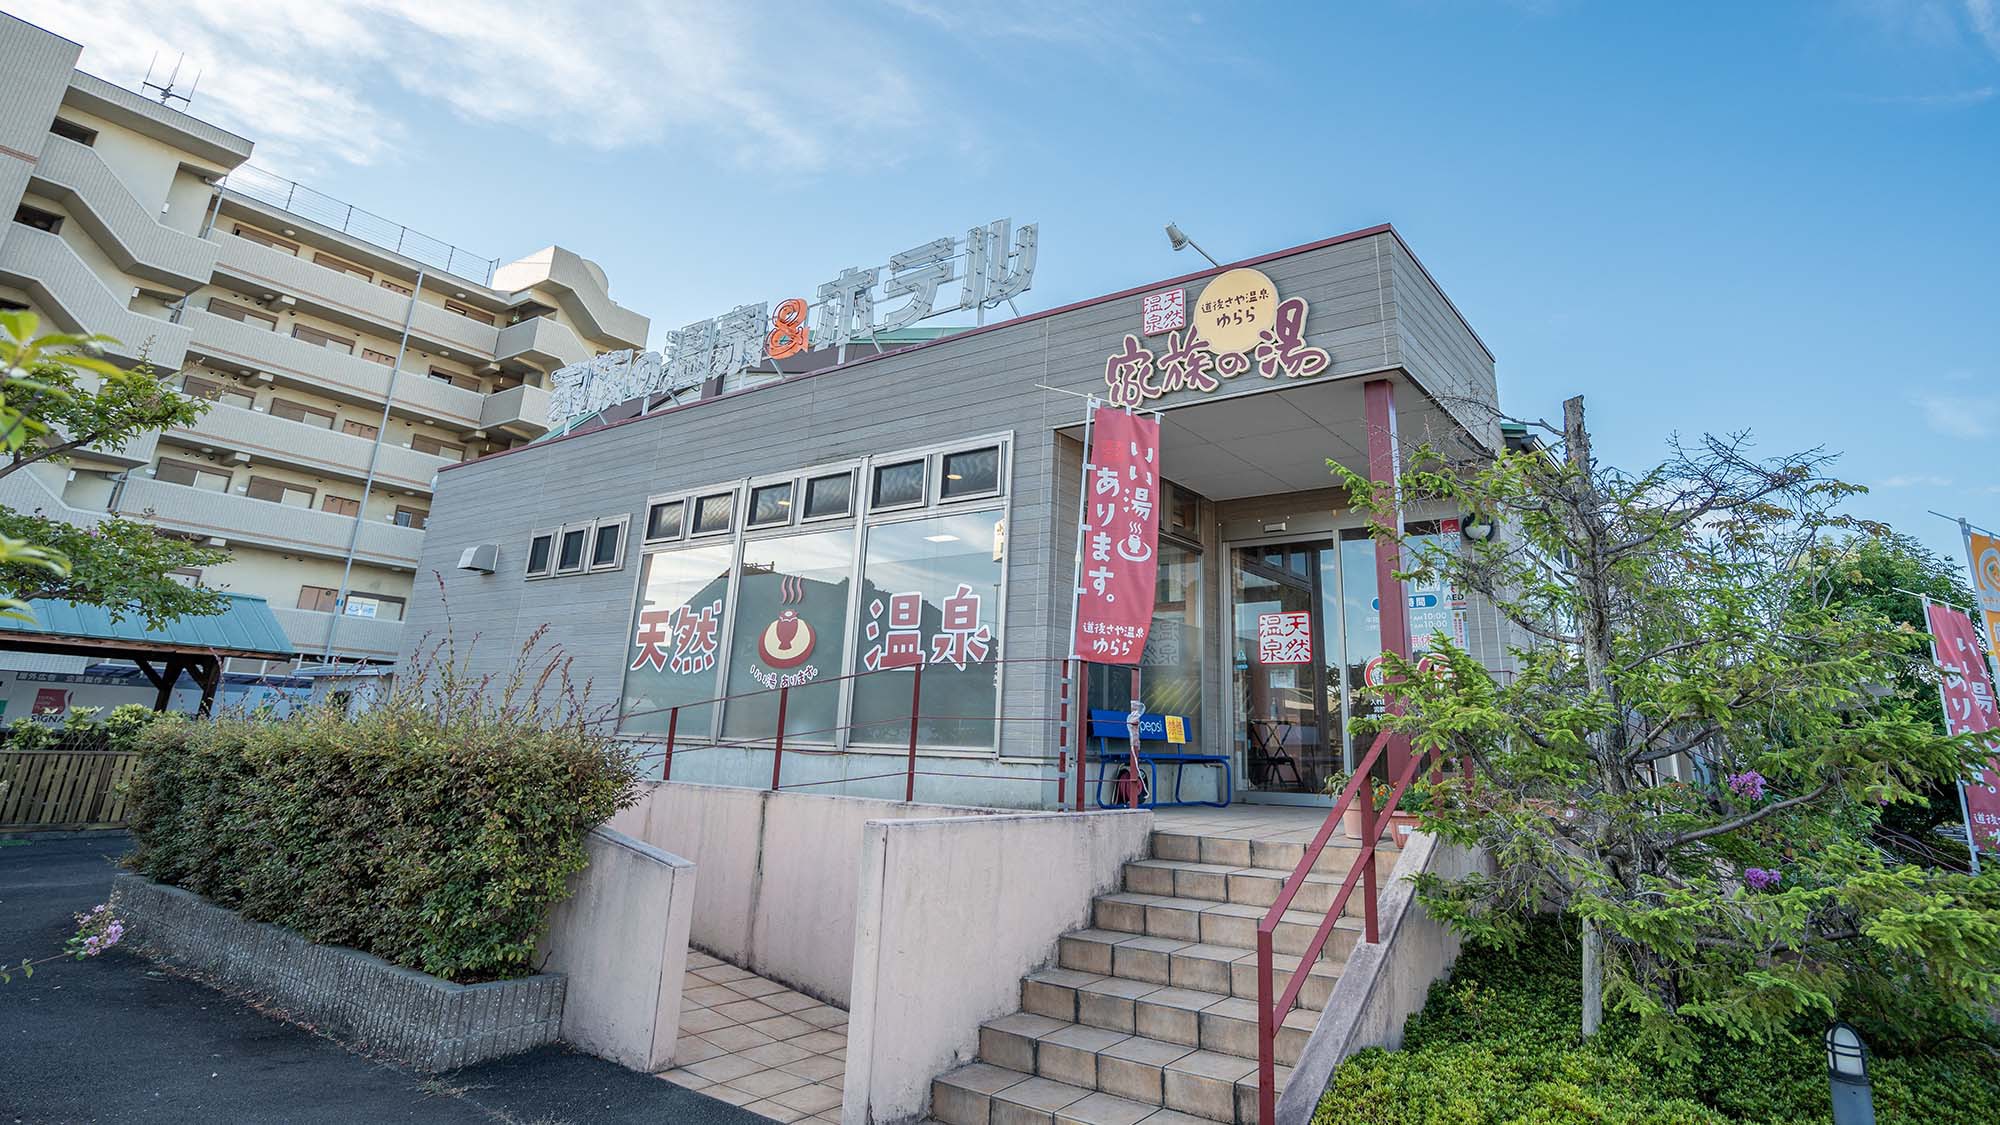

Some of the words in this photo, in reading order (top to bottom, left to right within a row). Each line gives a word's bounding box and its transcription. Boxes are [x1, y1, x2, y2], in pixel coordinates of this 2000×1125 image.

[1201, 287, 1269, 314] 道後さや温泉
[1216, 306, 1256, 329] ゆらら
[1106, 297, 1331, 407] 家族の湯
[1123, 441, 1154, 521] いい湯
[1087, 466, 1120, 603] あります。
[630, 598, 724, 675] 天然
[863, 583, 993, 672] 温泉
[1083, 622, 1145, 639] 道後さや温泉
[1260, 615, 1285, 662] 温泉
[1285, 615, 1311, 661] 天然
[1093, 638, 1134, 656] ゆらら
[749, 664, 777, 690] いい湯
[780, 665, 819, 688] あります。
[1140, 720, 1163, 734] pepsi
[1974, 813, 2000, 826] 道後
